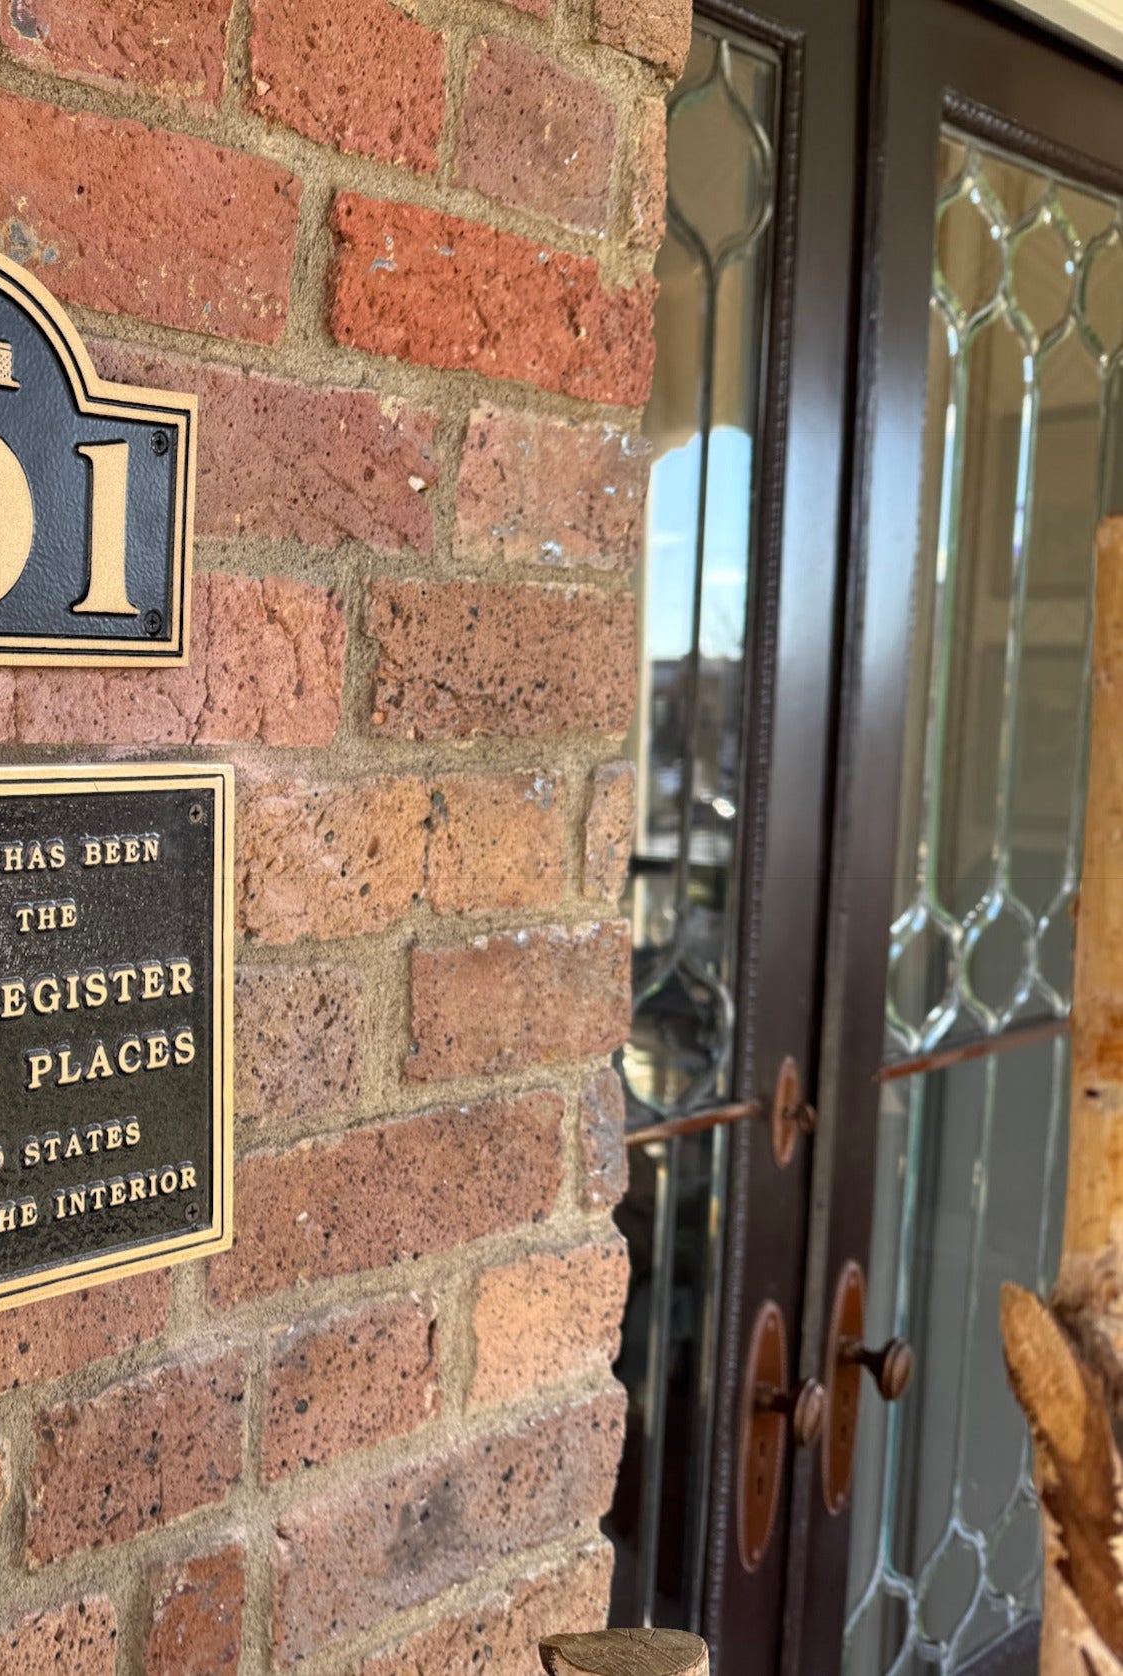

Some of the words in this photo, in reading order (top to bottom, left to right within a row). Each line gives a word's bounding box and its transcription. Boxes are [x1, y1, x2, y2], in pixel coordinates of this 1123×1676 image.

[4, 844, 66, 871] HAS
[84, 839, 158, 865] BEEN
[17, 904, 78, 931] THE
[28, 1031, 196, 1089] PLACES
[24, 1121, 141, 1163] STATES
[56, 1166, 197, 1218] INTERIOR
